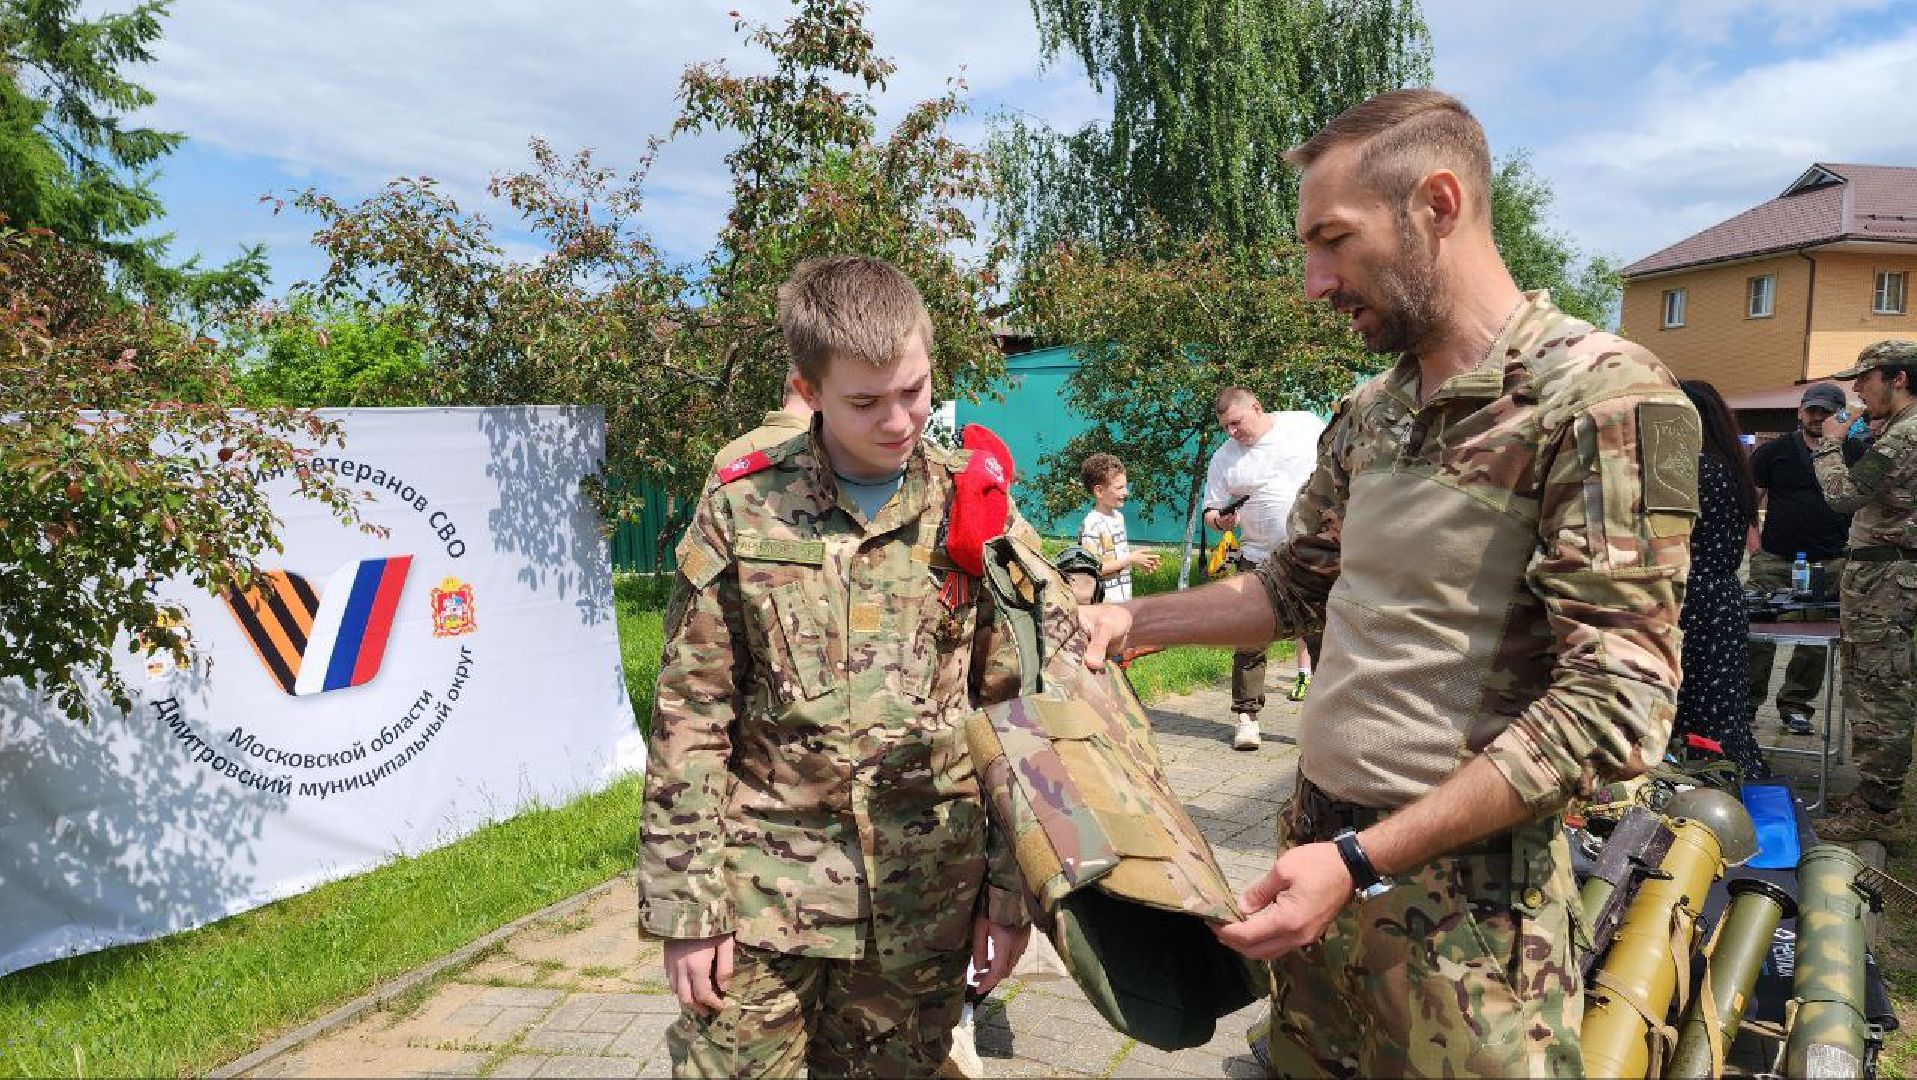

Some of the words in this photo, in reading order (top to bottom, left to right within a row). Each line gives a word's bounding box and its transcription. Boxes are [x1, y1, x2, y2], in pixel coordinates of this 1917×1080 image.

[428, 511, 466, 559] СВО
[150, 697, 292, 796] Дмитровский
[299, 702, 453, 799] муниципальный
[448, 645, 474, 702] округ
[228, 726, 366, 769] Московской
[370, 689, 433, 752] области
